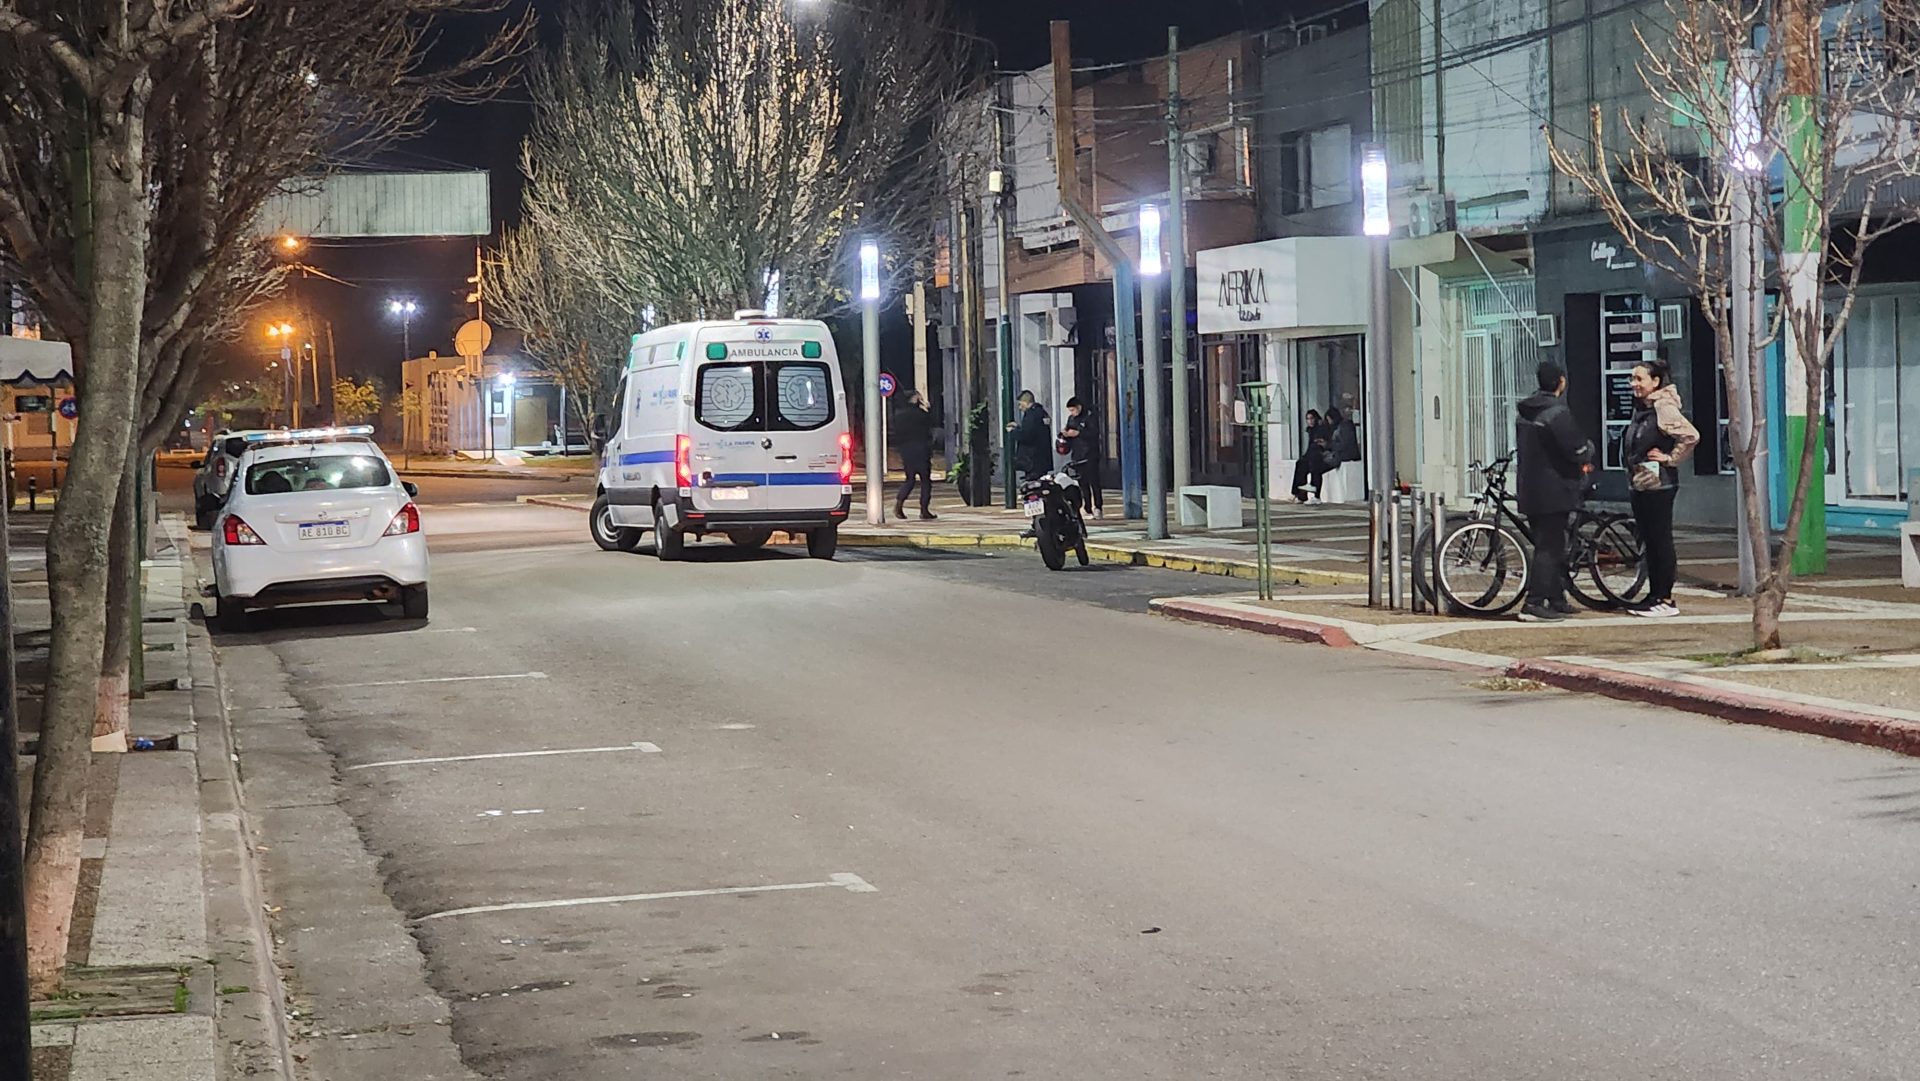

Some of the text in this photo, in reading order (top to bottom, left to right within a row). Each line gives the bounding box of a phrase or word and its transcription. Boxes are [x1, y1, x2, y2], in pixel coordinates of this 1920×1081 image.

[1218, 268, 1268, 307] AFRIKA
[731, 348, 799, 357] AMBULANCIA
[302, 528, 313, 538] AE
[316, 527, 333, 537] 810
